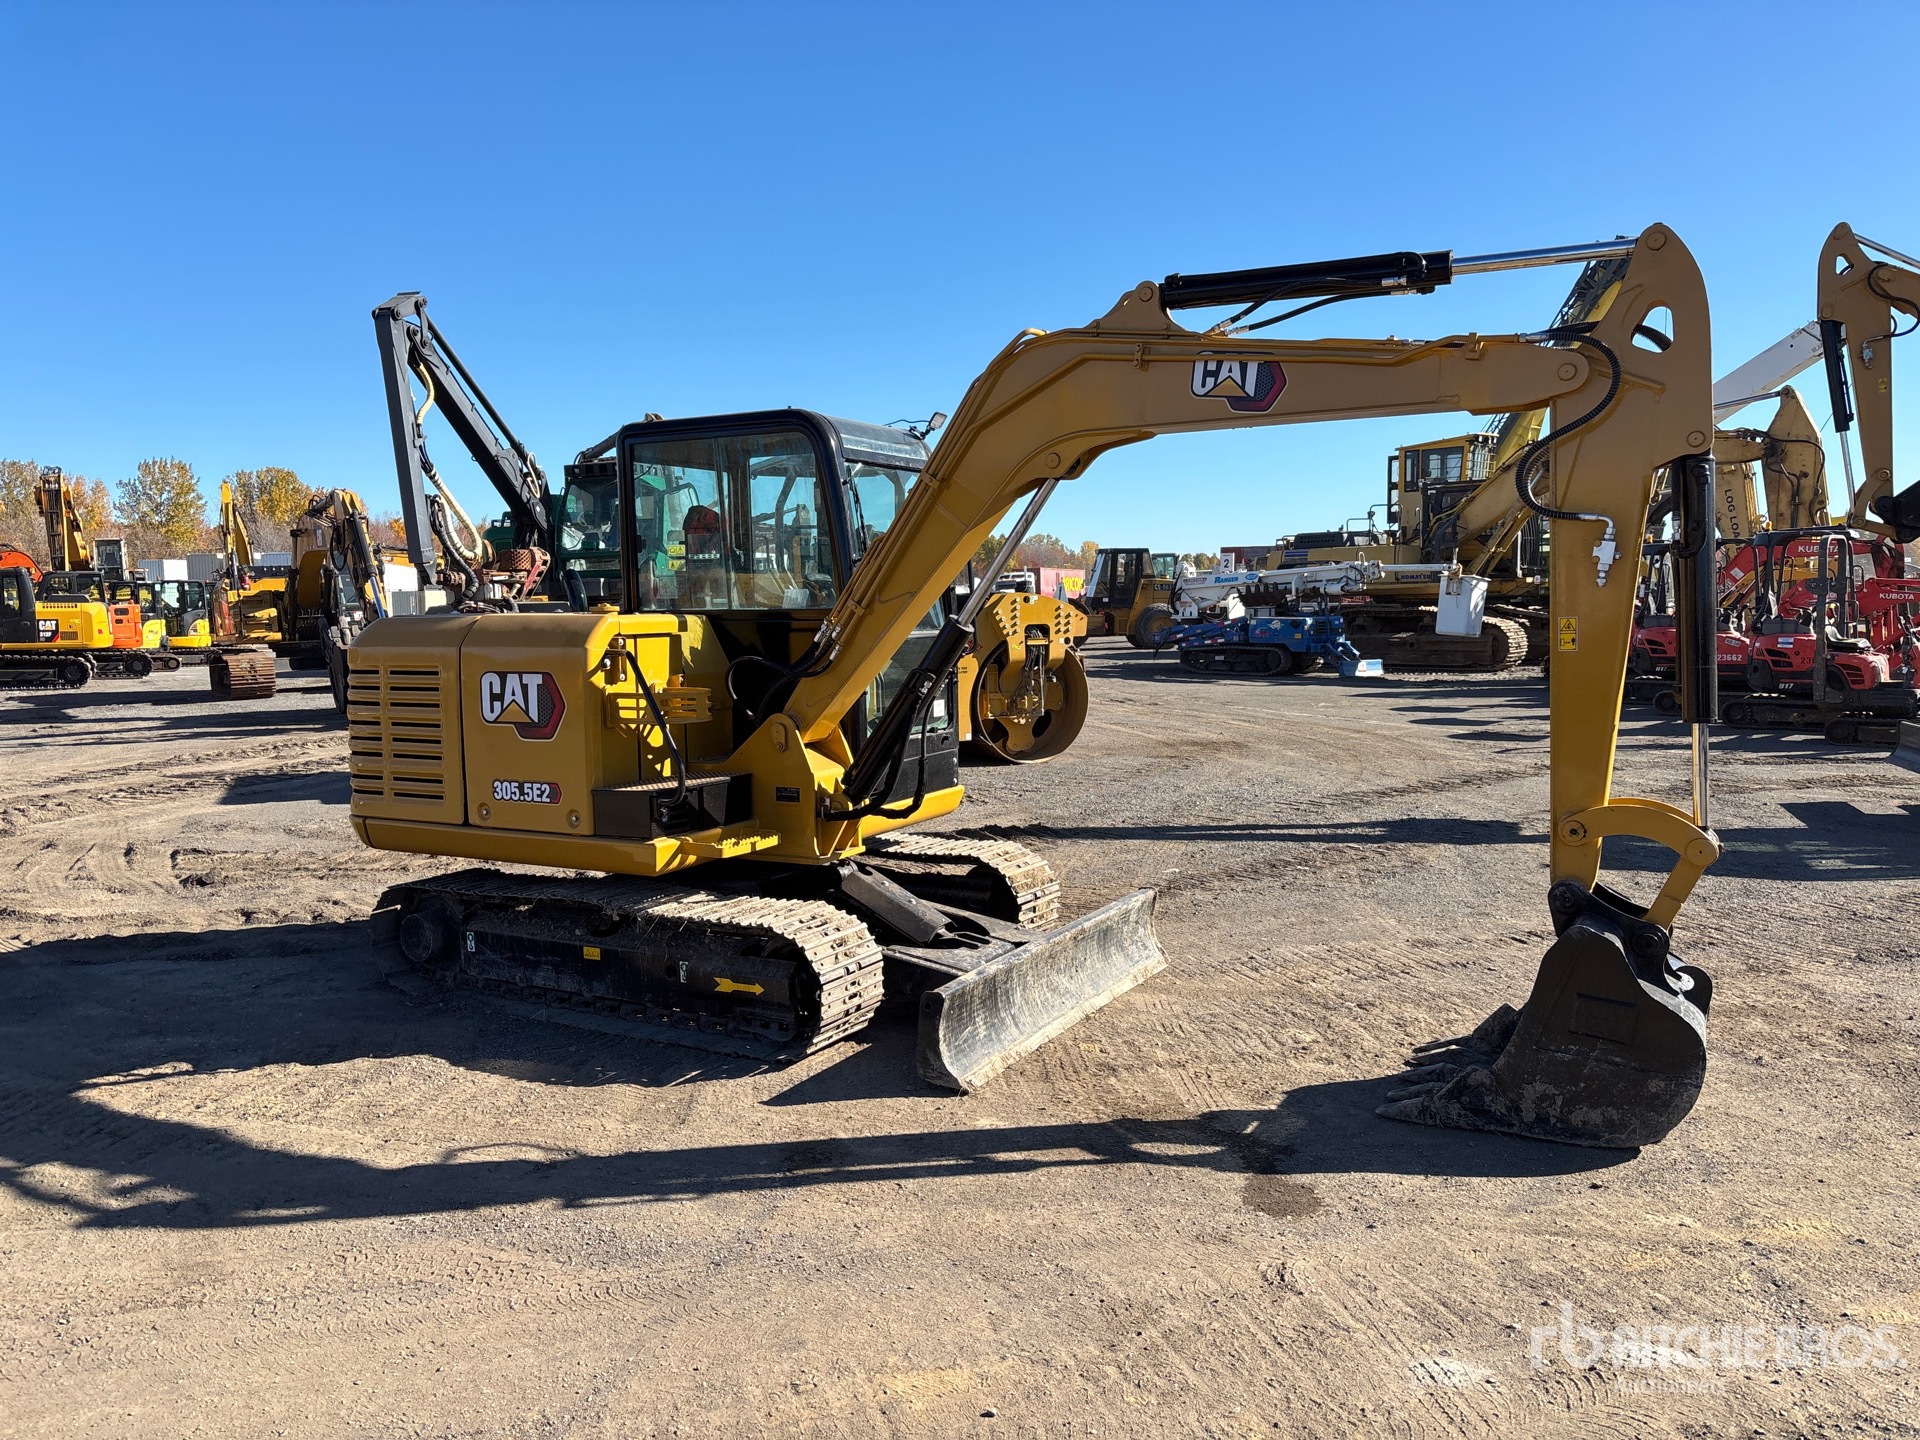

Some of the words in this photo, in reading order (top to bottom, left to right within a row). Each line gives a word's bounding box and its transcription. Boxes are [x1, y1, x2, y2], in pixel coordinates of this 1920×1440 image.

[1192, 352, 1265, 397] CAT
[1724, 489, 1735, 512] LOG
[1797, 545, 1839, 553] KUBTA
[1223, 558, 1230, 569] 2
[1879, 592, 1915, 600] KUBOTA
[38, 620, 57, 631] CAT
[1717, 654, 1742, 662] 23662
[481, 672, 543, 723] CAT
[493, 780, 551, 803] 305.5E2
